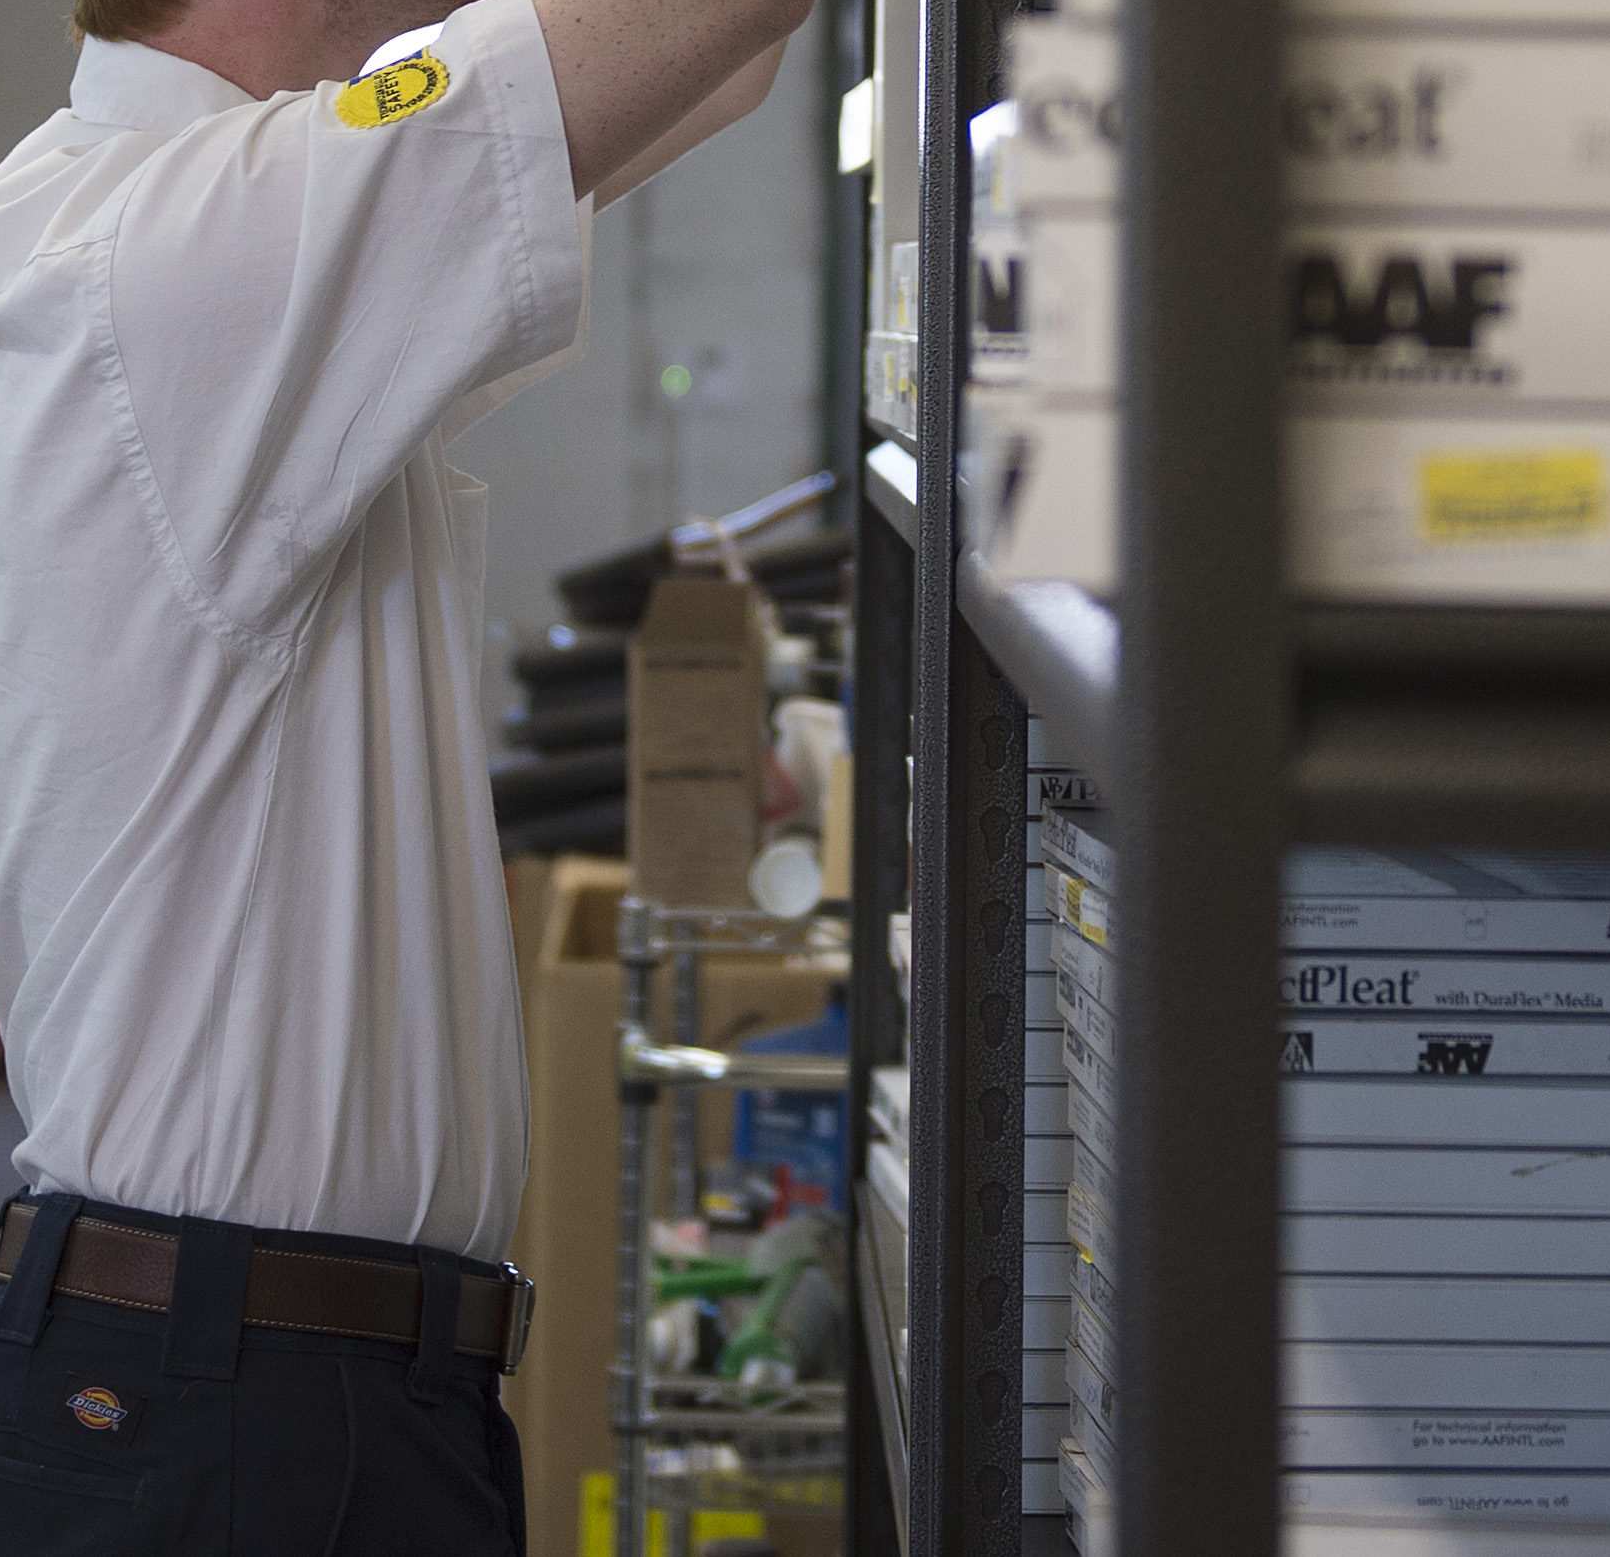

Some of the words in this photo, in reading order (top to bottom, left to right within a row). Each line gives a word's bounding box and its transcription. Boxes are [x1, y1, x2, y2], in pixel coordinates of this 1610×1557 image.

[383, 70, 403, 113] SAFETY
[1435, 990, 1470, 1005] with
[1556, 993, 1603, 1009] Media
[74, 1397, 121, 1419] Dickies
[1413, 1420, 1432, 1433] For
[1437, 1420, 1491, 1433] technical
[1495, 1421, 1567, 1434] information
[1412, 1436, 1428, 1449] go
[1432, 1435, 1445, 1447] to
